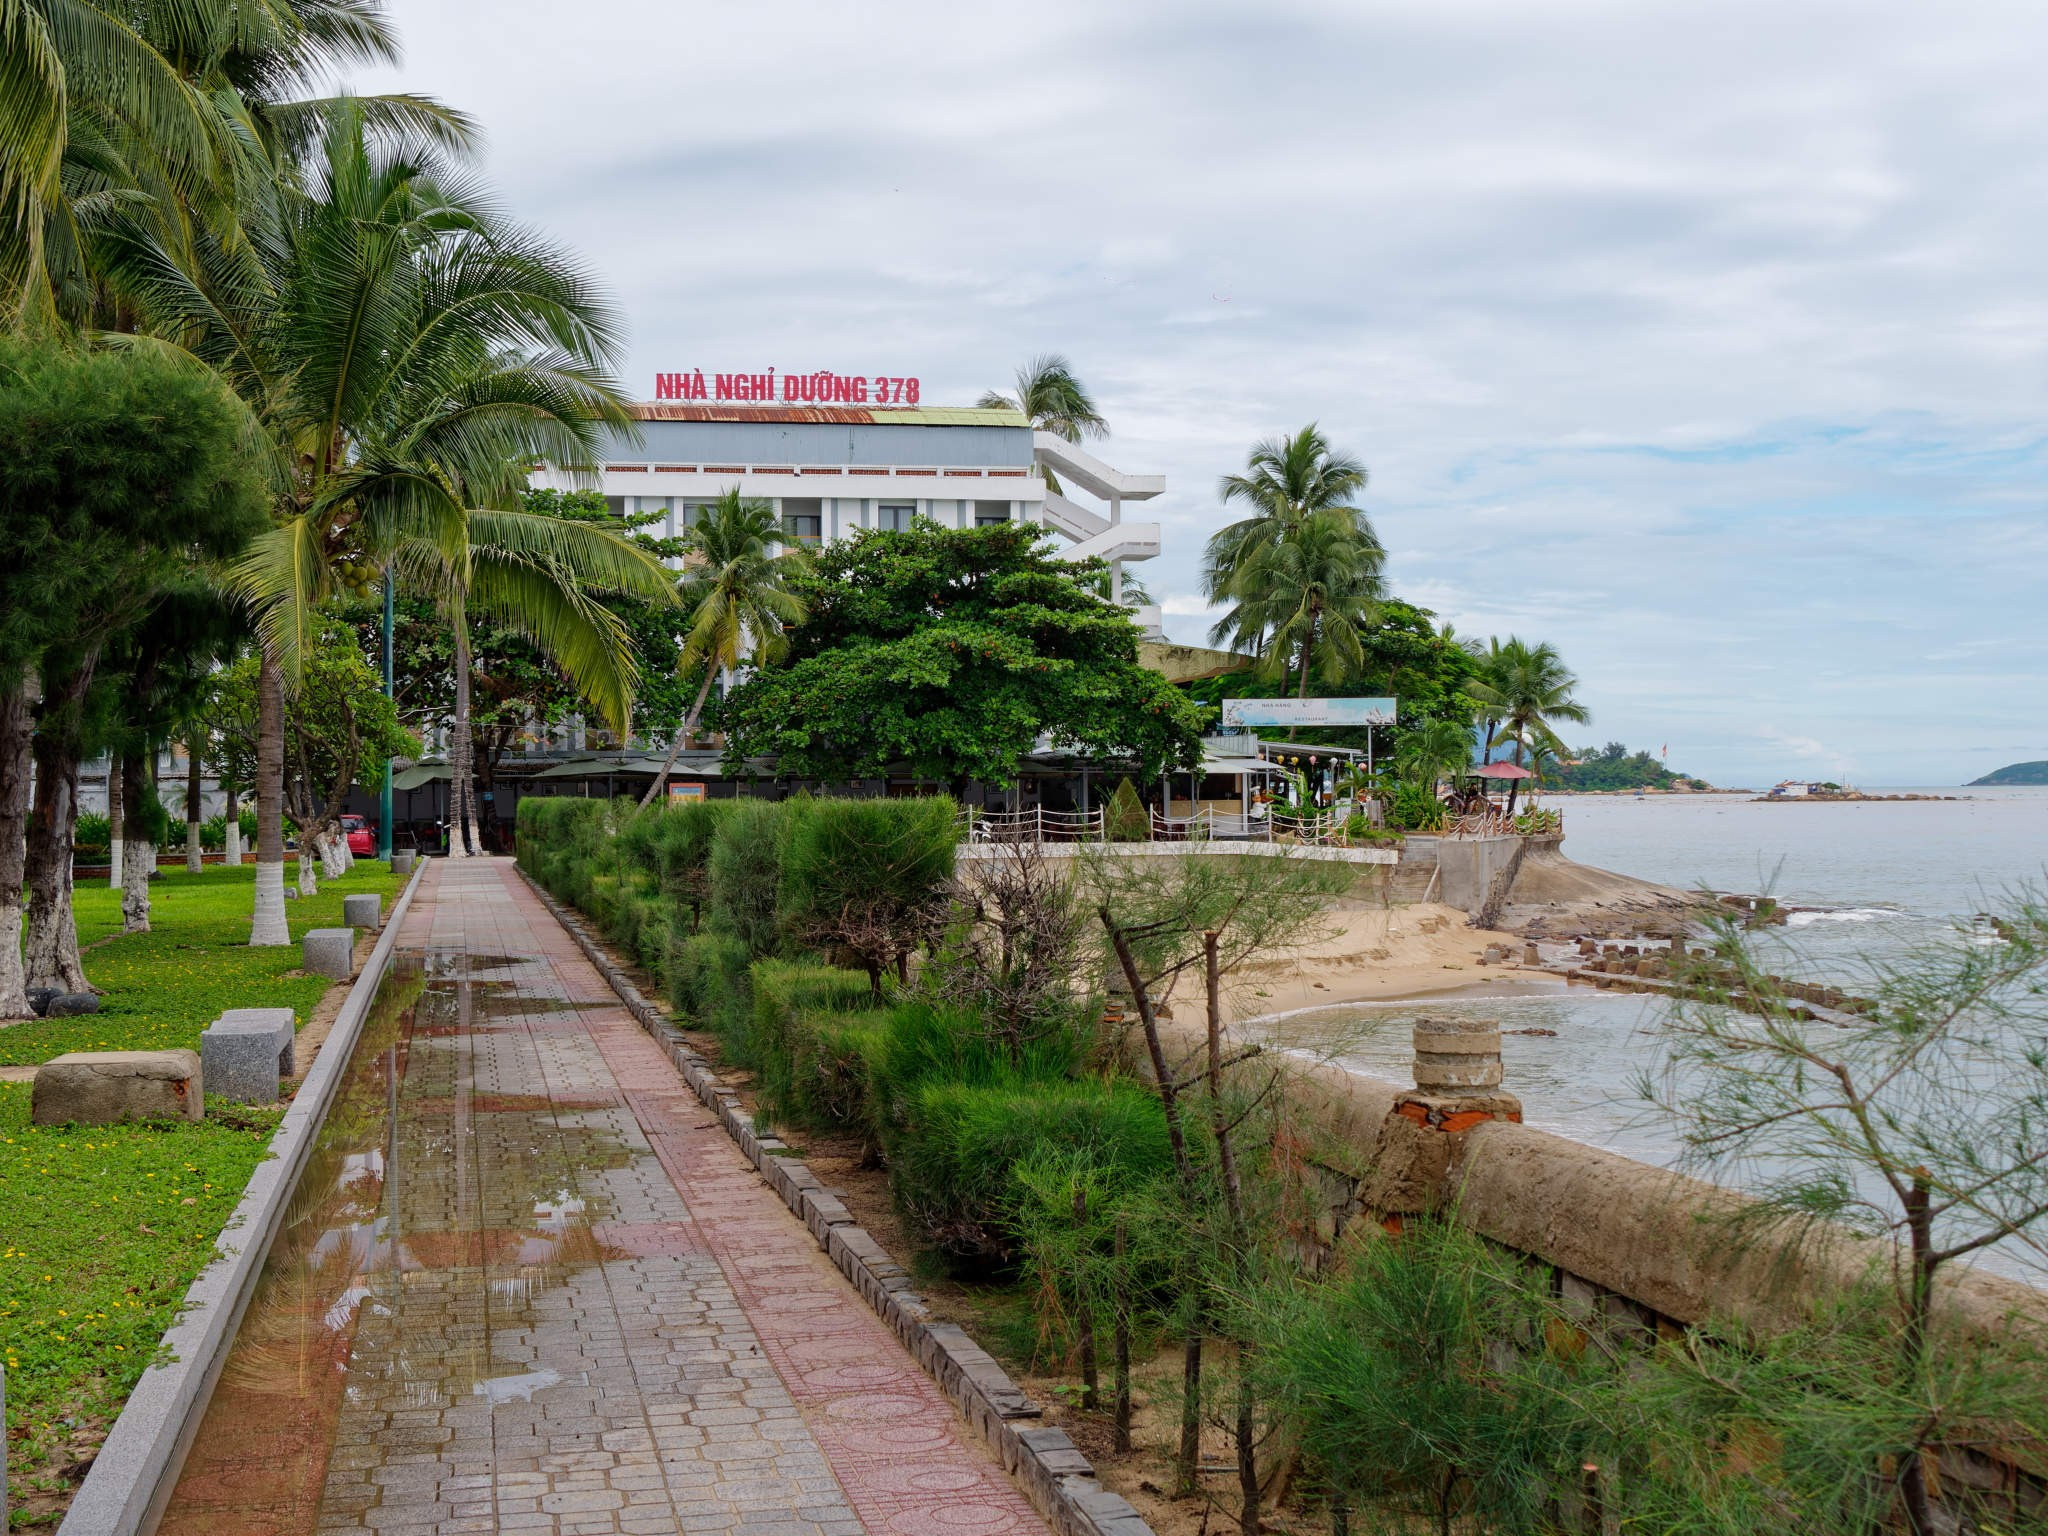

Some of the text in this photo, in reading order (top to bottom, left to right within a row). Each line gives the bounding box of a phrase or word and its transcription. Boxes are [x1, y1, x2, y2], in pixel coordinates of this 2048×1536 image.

[656, 367, 920, 403] NHÀ NGHỈ DƯỠNG 378
